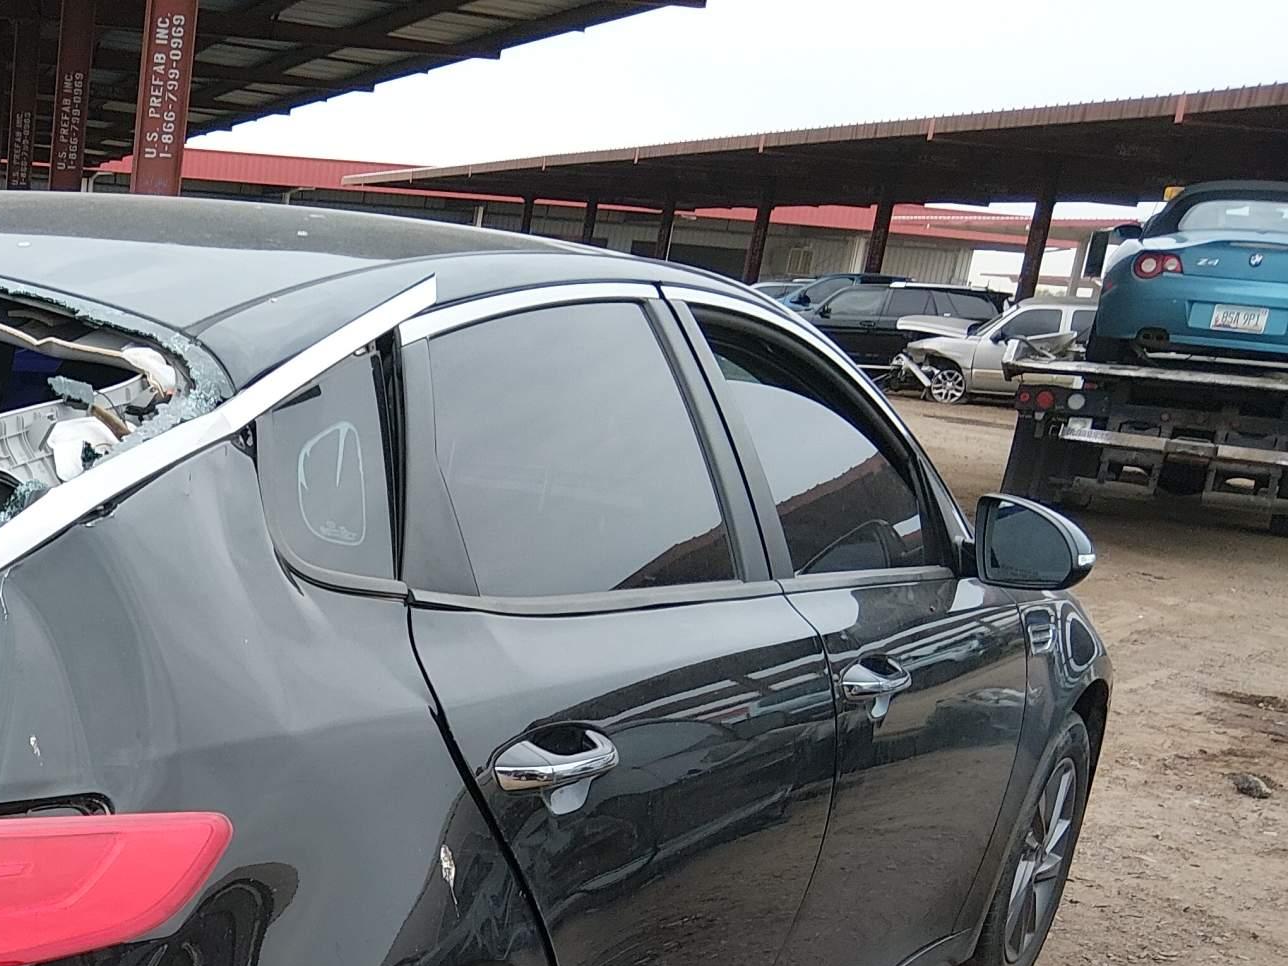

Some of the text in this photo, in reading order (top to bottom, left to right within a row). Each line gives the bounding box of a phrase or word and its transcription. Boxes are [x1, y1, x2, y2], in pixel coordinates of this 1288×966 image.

[59, 98, 72, 142] PREFAB
[67, 72, 84, 169] 1-866-799-0969
[148, 53, 167, 118] PREFAB
[159, 14, 185, 158] 1-866-799-0969
